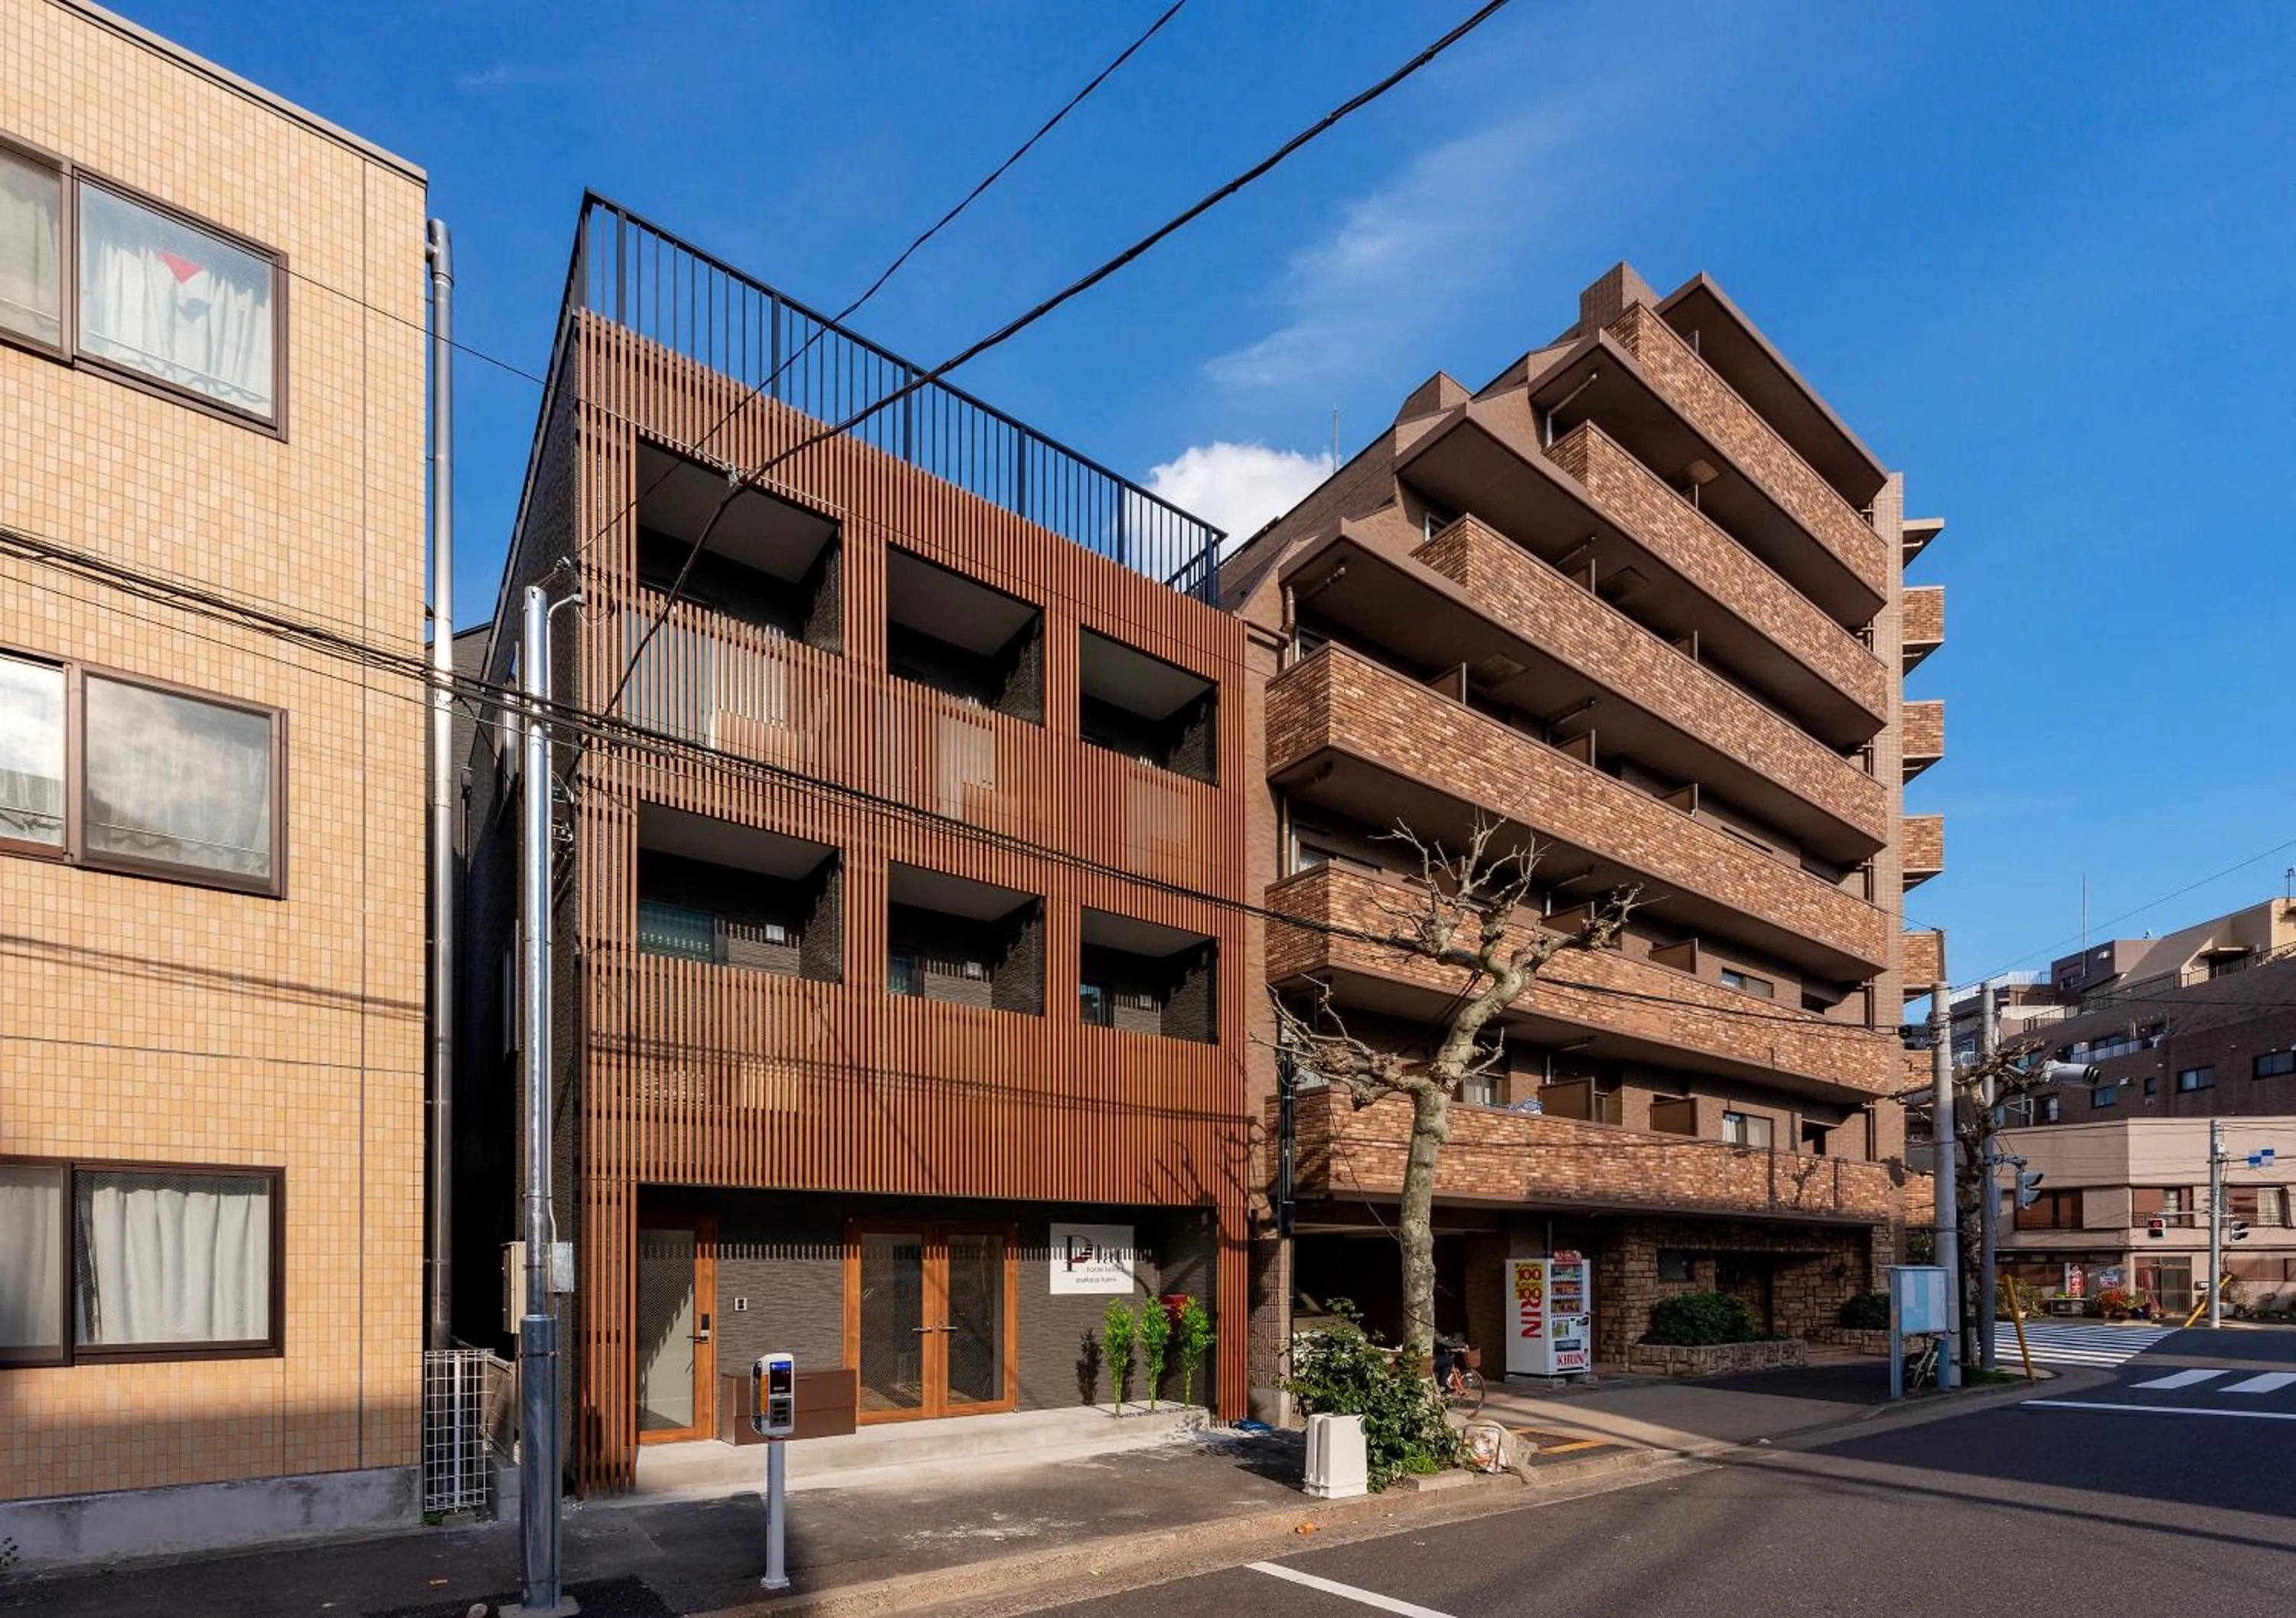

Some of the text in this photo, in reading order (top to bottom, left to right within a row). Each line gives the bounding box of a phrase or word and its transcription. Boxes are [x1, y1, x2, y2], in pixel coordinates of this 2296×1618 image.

[1516, 1268, 1542, 1280] 100
[1516, 1287, 1542, 1300] 100
[1521, 1299, 1542, 1338] RIN
[1556, 1352, 1583, 1366] KIRIN
